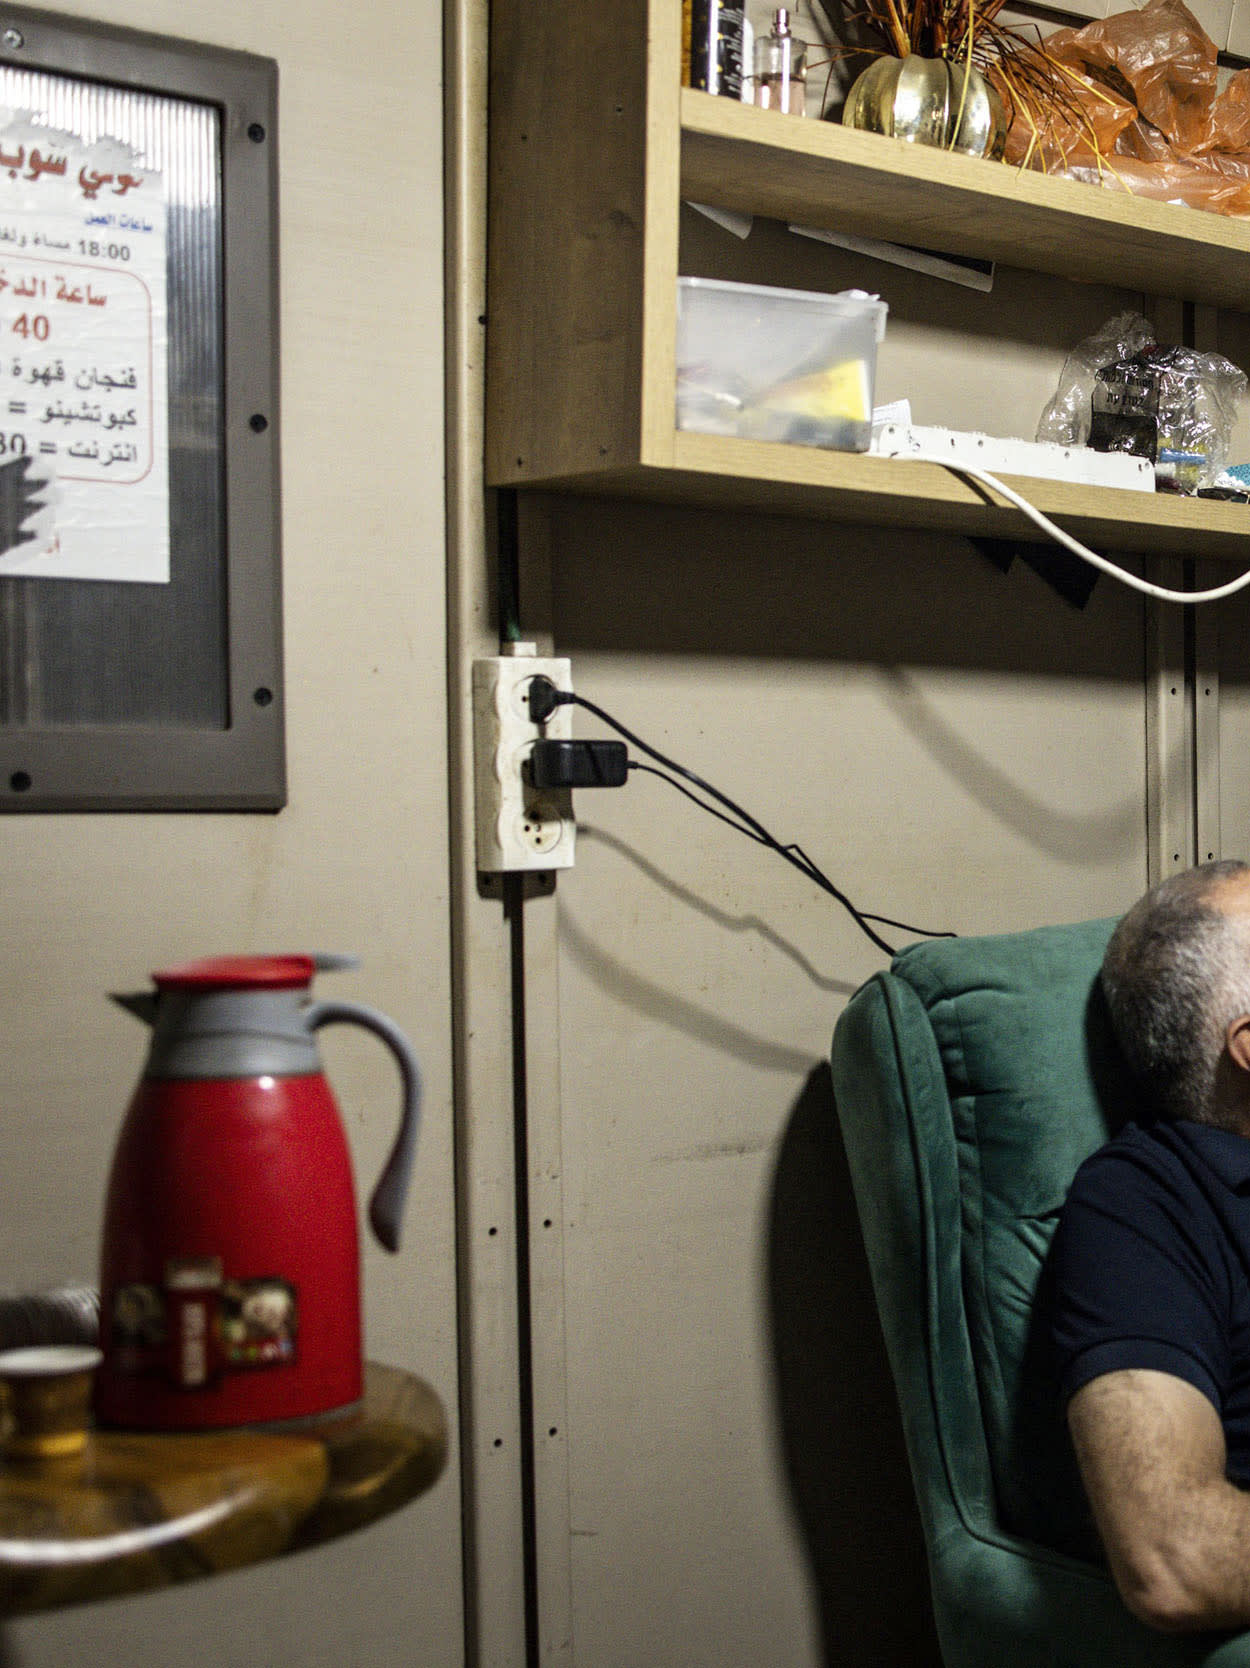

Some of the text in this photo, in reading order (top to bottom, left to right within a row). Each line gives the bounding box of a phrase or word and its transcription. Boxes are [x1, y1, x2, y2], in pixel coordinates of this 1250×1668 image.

[79, 239, 131, 261] 18:00
[56, 274, 107, 307] ساعة
[12, 312, 50, 341] 40
[12, 357, 137, 392] فنجان قهوة
[40, 400, 137, 430] كبوتشينو
[68, 440, 137, 466] انترنت
